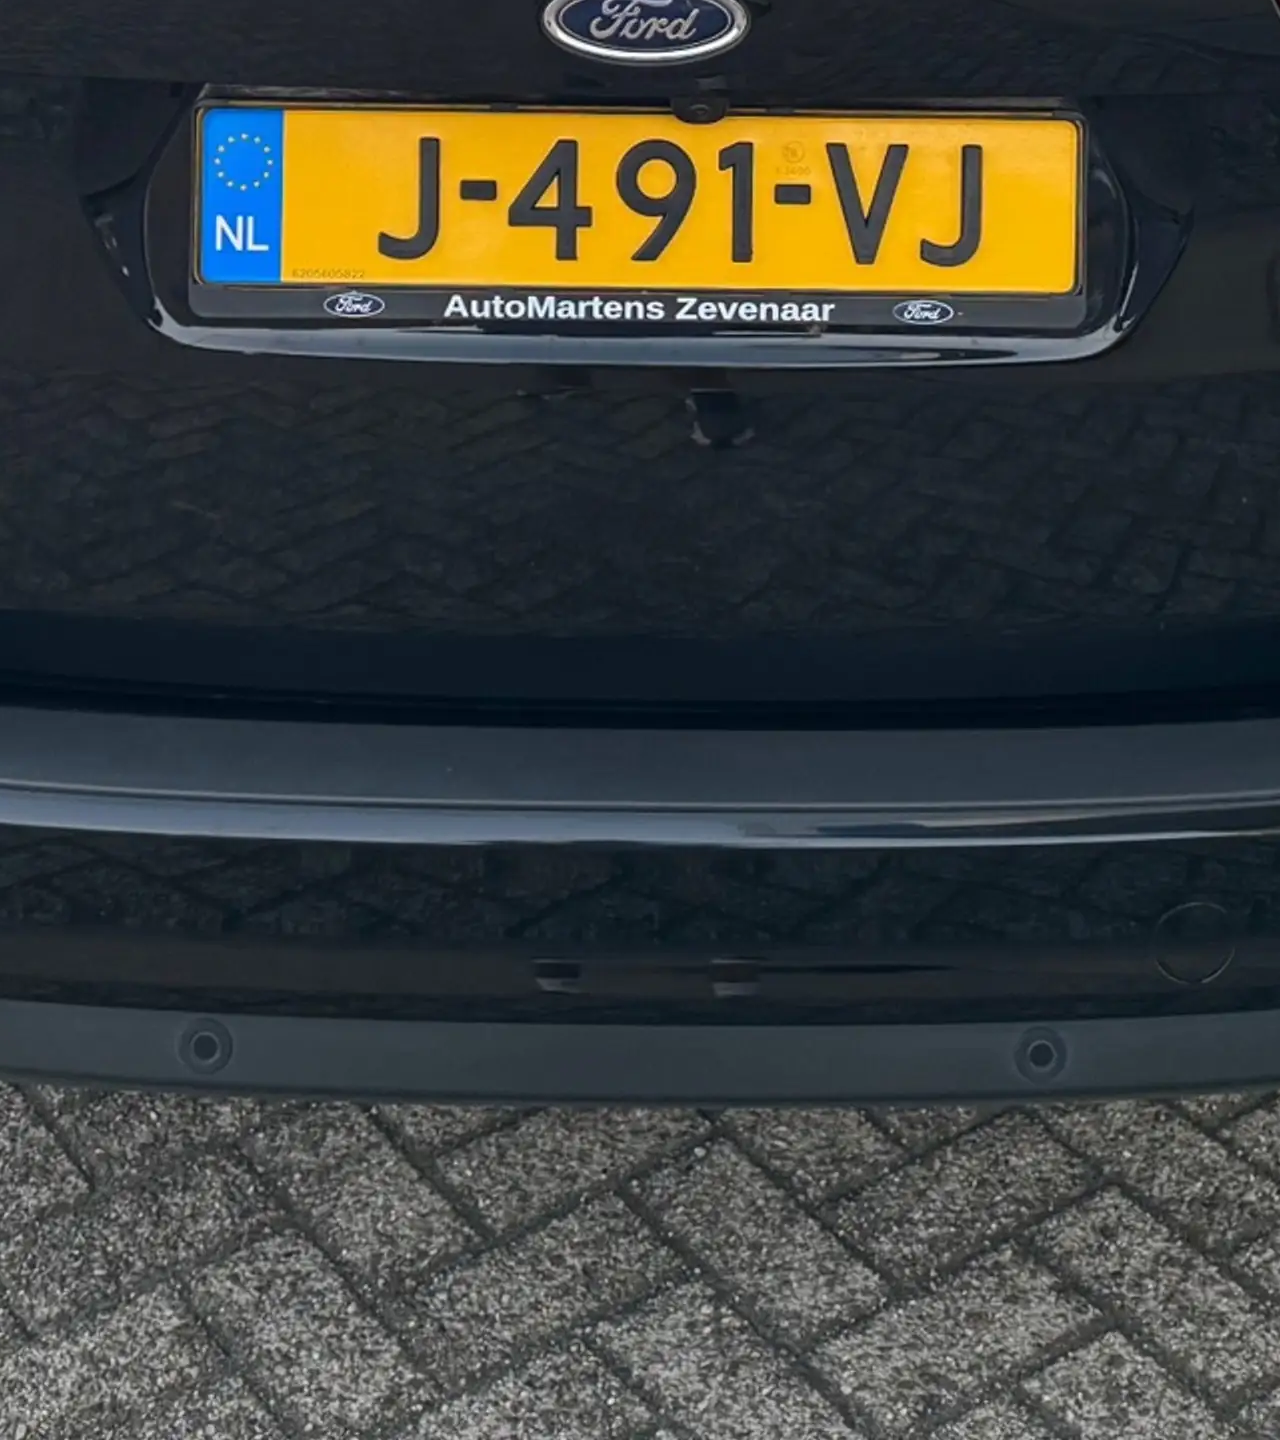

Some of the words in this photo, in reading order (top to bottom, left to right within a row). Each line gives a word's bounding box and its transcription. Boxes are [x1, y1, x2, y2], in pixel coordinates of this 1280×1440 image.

[377, 137, 983, 268] J-491-VJ
[215, 214, 269, 252] NL
[444, 294, 665, 320] AutoMartens
[675, 297, 835, 322] Zevenaar
